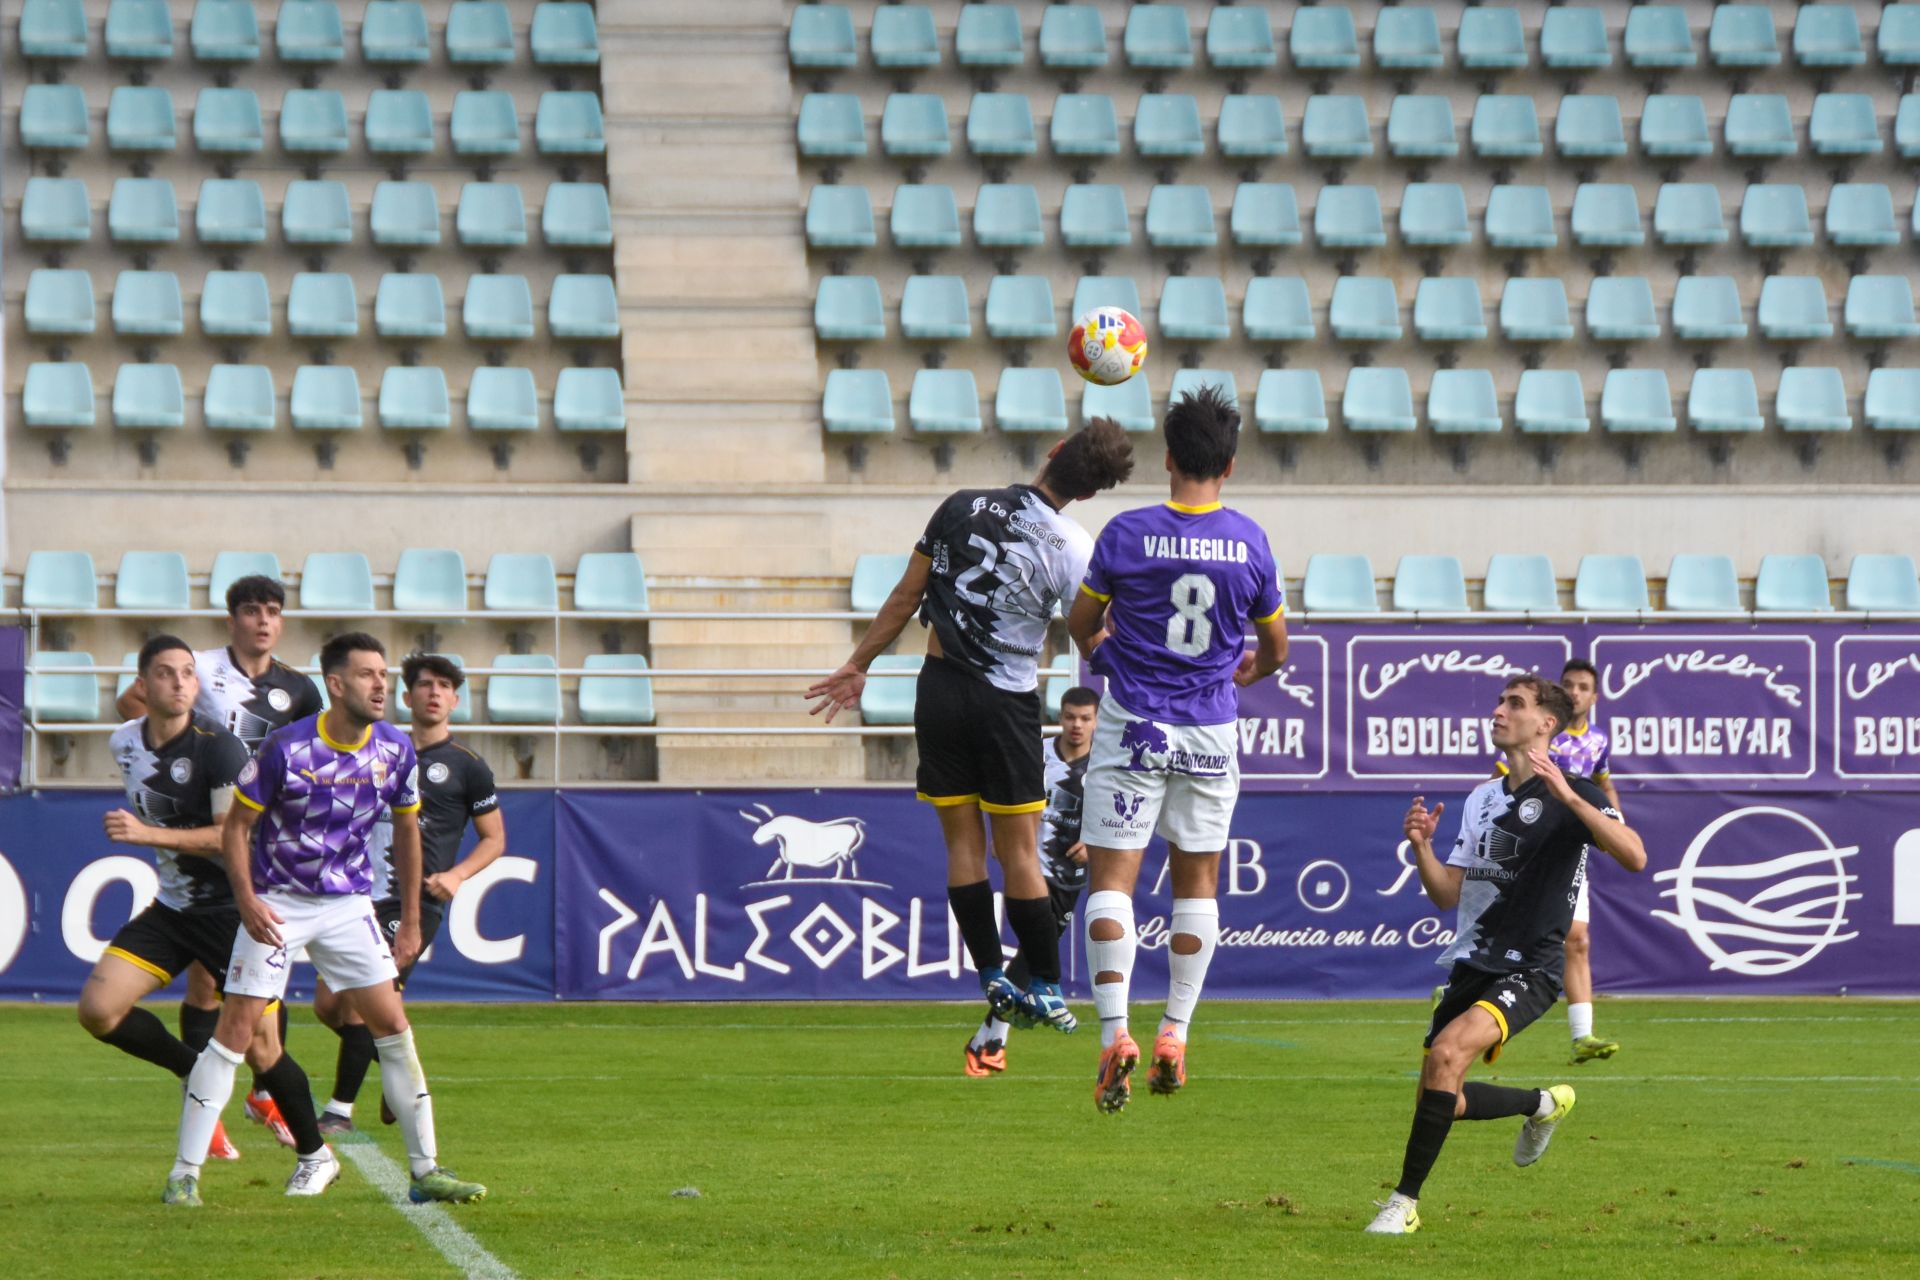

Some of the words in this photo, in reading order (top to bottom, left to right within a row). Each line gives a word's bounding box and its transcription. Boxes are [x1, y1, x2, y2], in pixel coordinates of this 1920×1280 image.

[988, 502, 1007, 517] De
[1008, 511, 1046, 540] Castro
[1047, 534, 1067, 551] Gil
[1165, 573, 1216, 658] 8
[1367, 716, 1496, 755] BOULEV
[1610, 716, 1792, 759] BOULEVAR
[1100, 818, 1125, 829] Sdad
[1216, 923, 1328, 949] xcelencia
[1333, 928, 1364, 947] en
[1364, 922, 1401, 947] la
